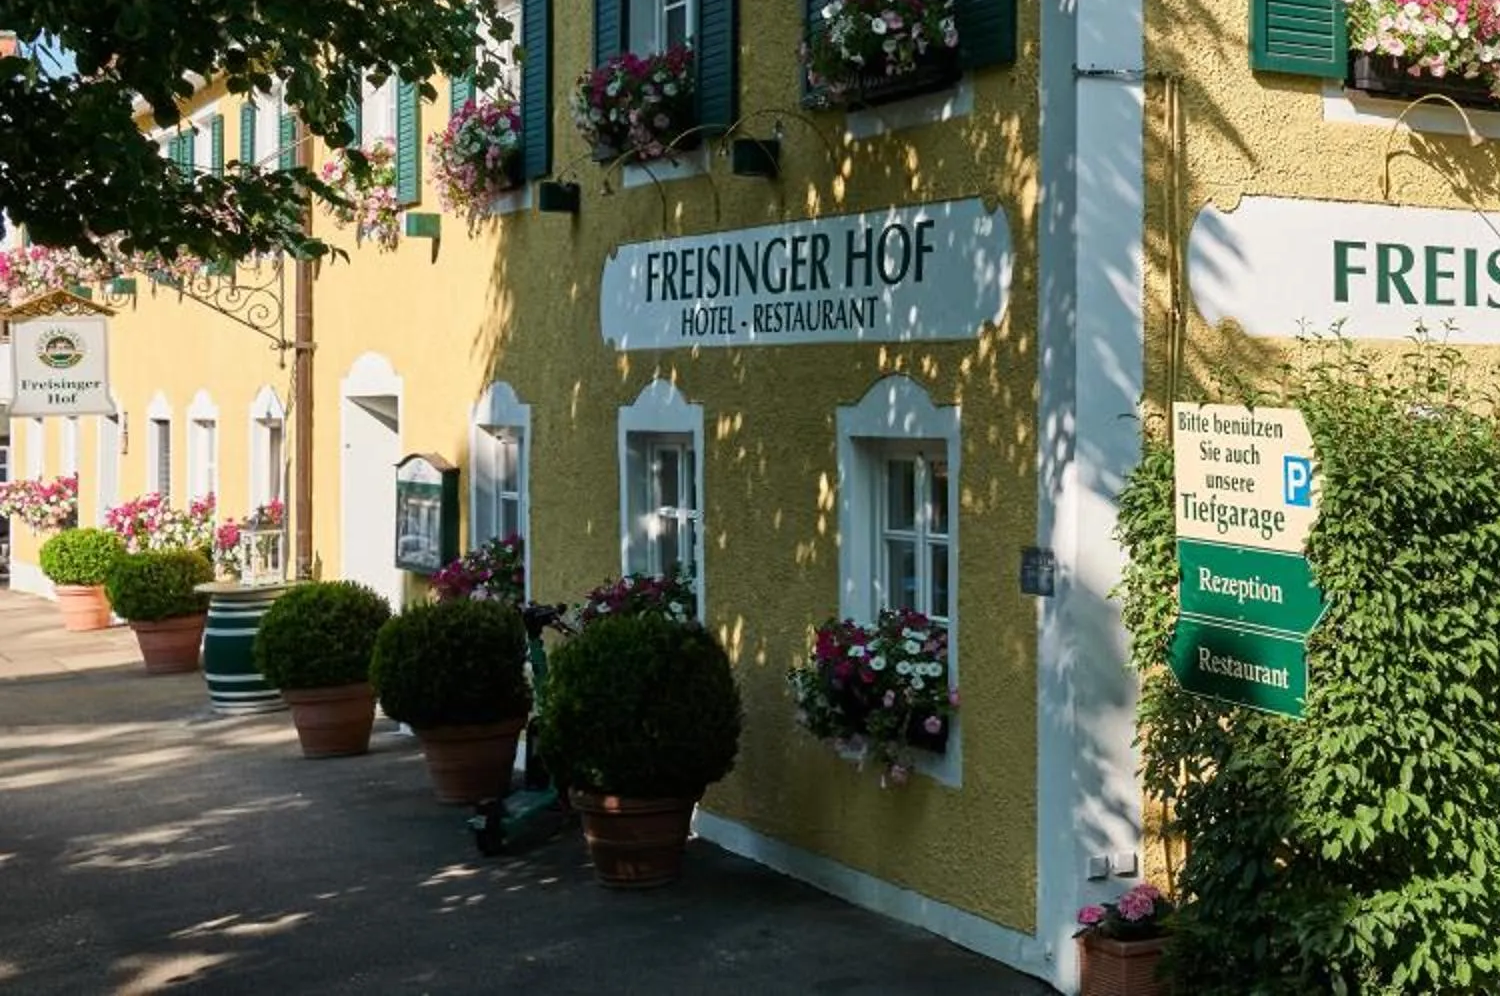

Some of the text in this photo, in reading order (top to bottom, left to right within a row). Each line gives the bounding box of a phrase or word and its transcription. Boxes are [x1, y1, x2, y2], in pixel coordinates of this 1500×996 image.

[646, 219, 936, 302] FREISINGER HOF
[681, 305, 736, 337] HOTEL
[753, 296, 879, 334] RESTAURANT
[21, 378, 102, 391] Freisinger
[48, 393, 77, 404] Hof
[1177, 411, 1284, 439] Bitte benützen
[1199, 440, 1261, 465] Sie auch
[1205, 473, 1255, 494] unsere
[1288, 461, 1308, 501] P
[1181, 492, 1286, 539] Tiefgarage
[1198, 567, 1284, 605] Rezeption
[1198, 646, 1291, 690] Restaurant
